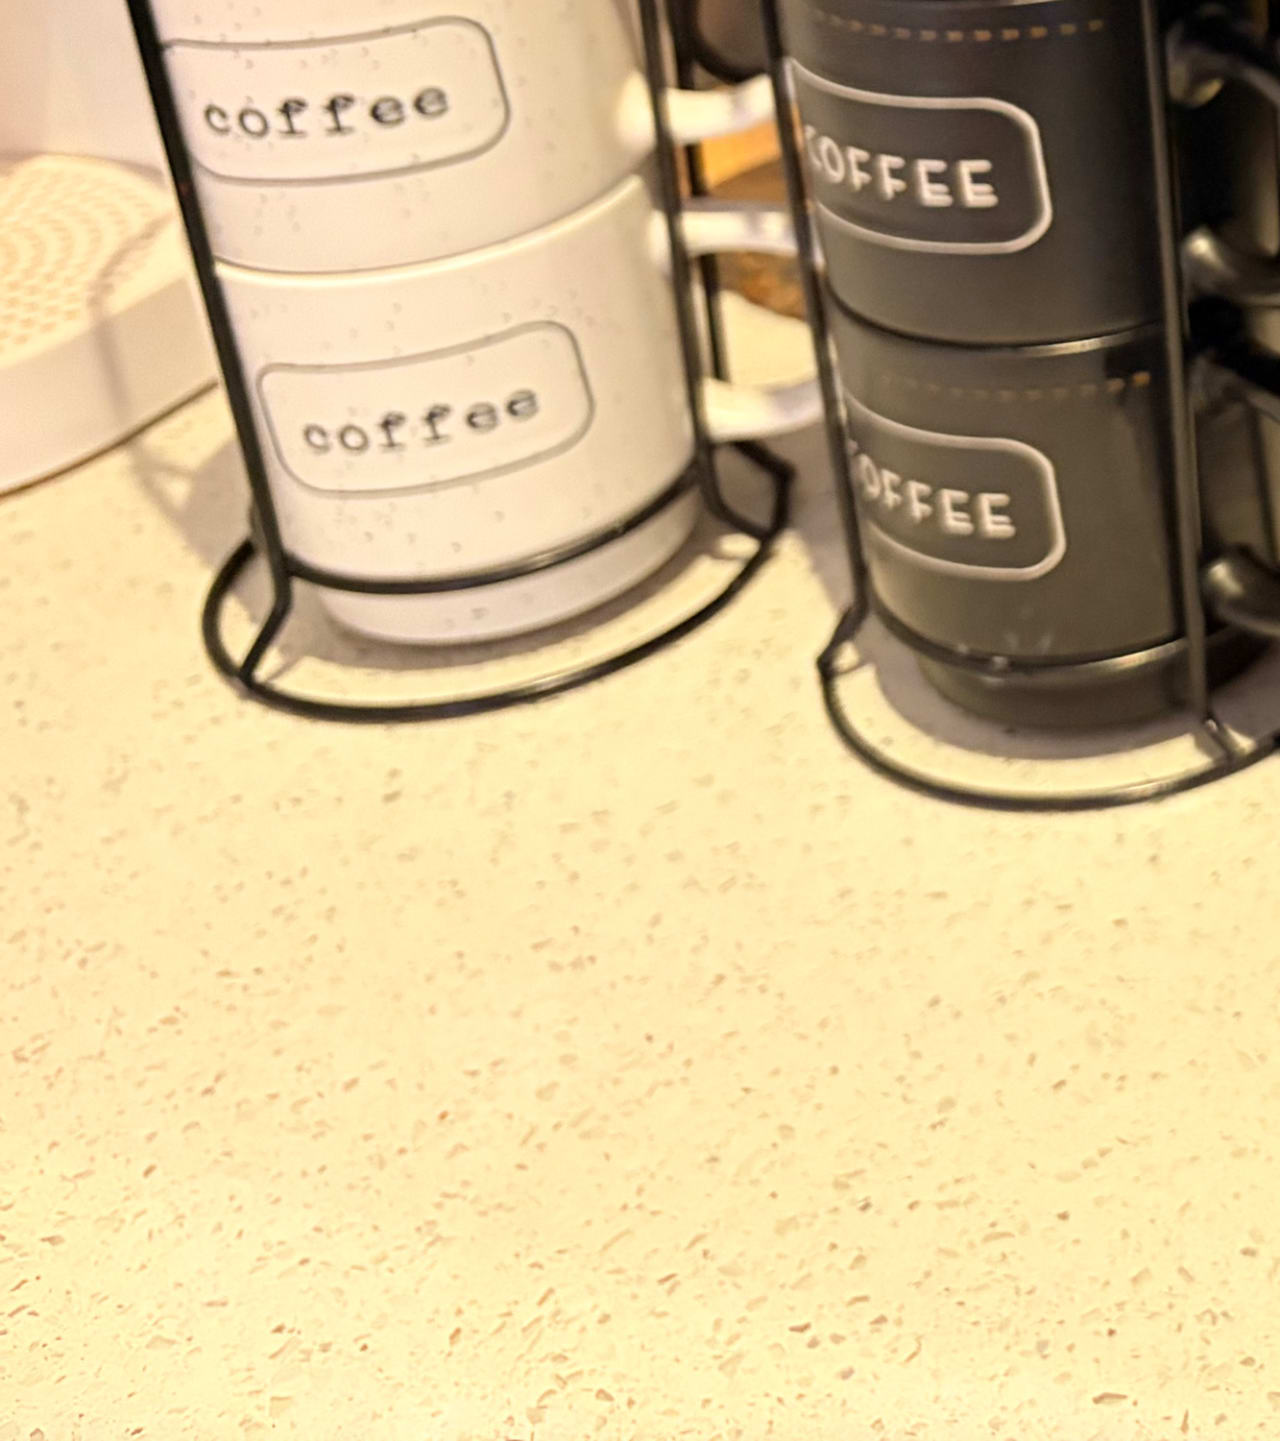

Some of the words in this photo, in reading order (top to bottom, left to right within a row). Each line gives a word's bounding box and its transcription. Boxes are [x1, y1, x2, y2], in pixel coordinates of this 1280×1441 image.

[202, 85, 449, 139] coffee
[303, 388, 540, 454] coffee
[847, 438, 1017, 540] OFFEE
